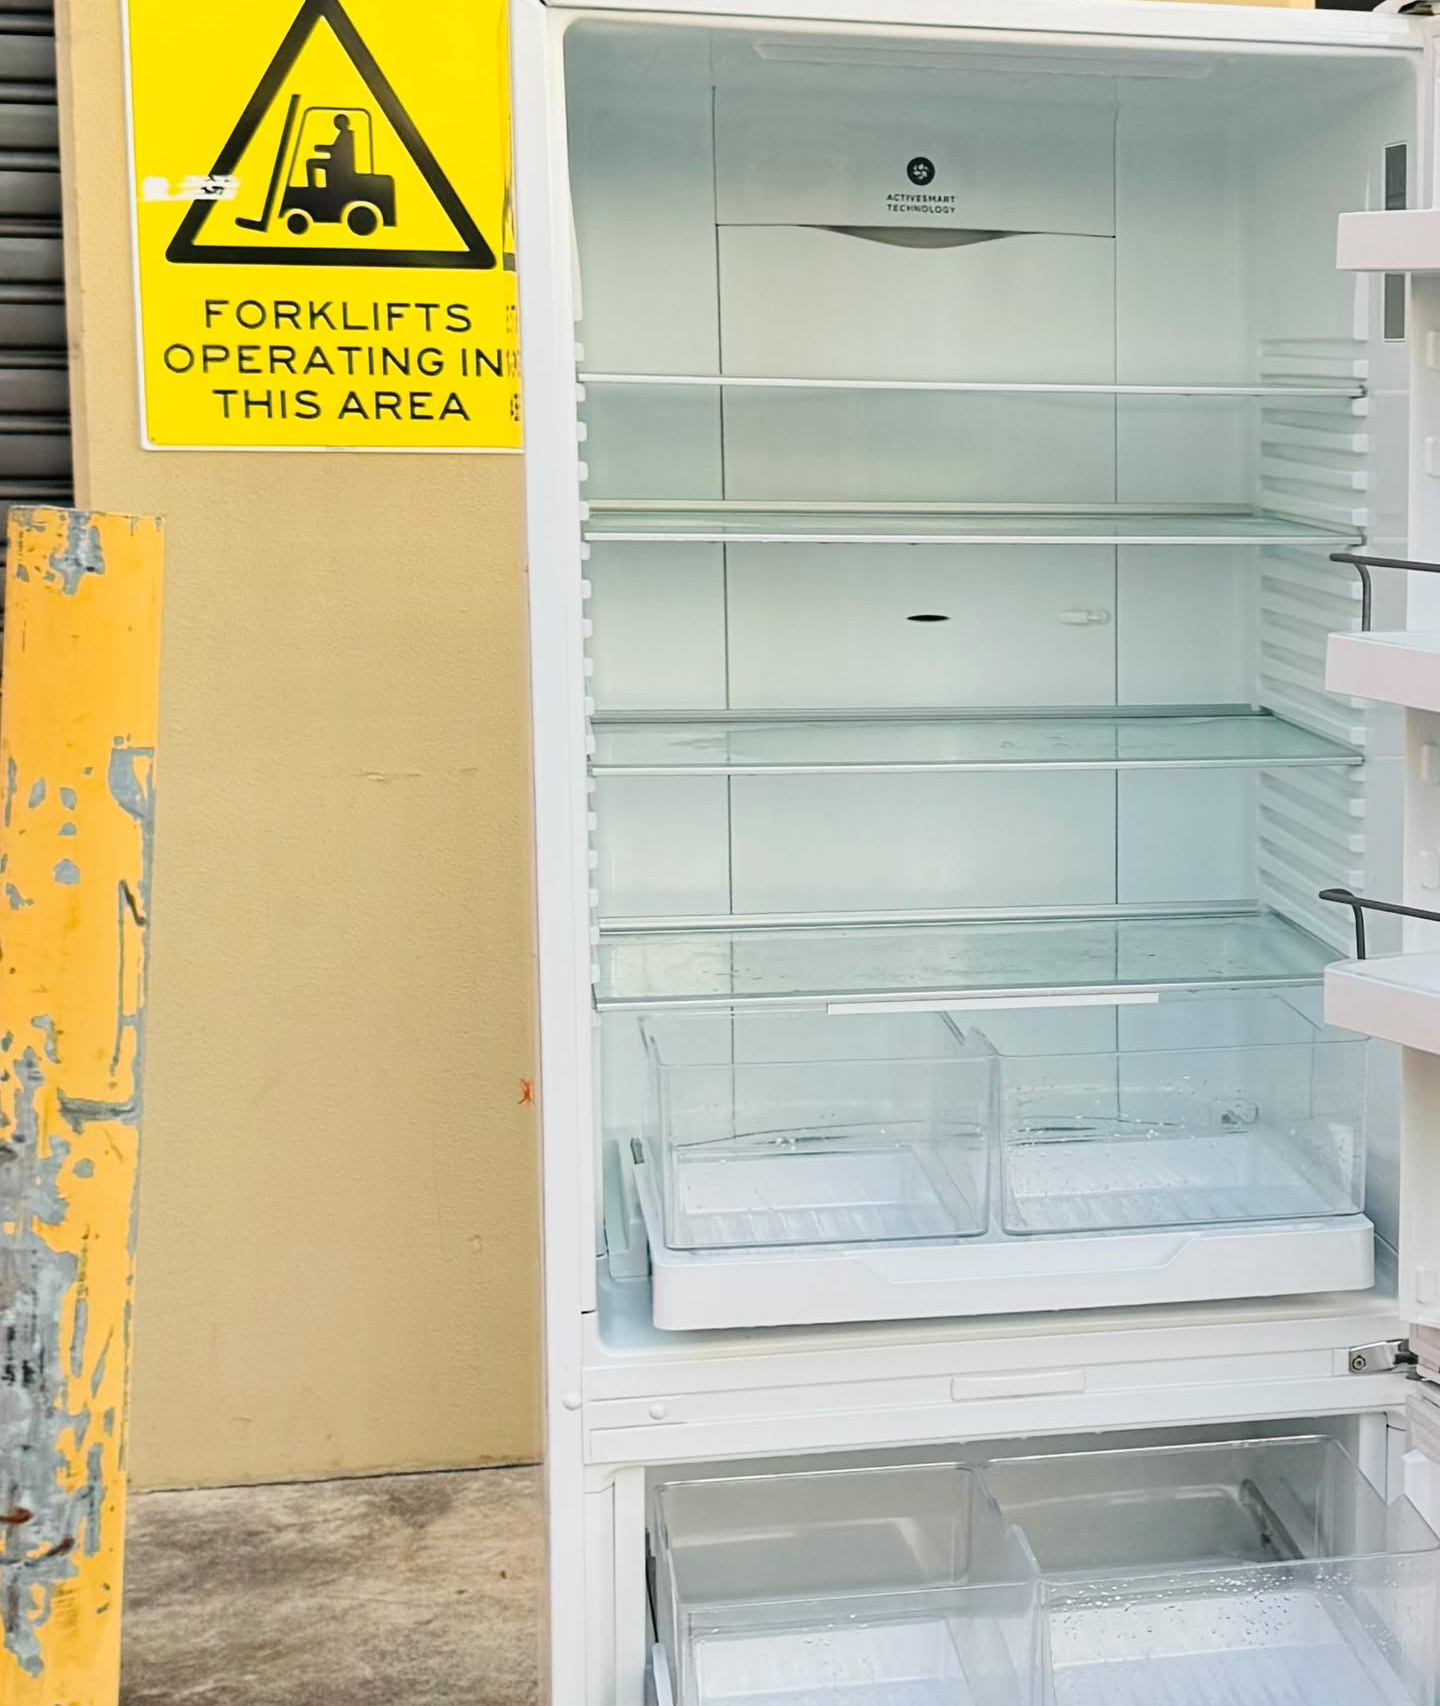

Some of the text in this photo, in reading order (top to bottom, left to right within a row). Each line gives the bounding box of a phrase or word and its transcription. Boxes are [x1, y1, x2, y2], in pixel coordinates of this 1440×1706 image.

[886, 193, 956, 203] ACTIVESMART
[887, 203, 956, 214] TECHNOLOGY
[204, 299, 473, 333] FORKLIFTS
[163, 343, 503, 378] OPERATING IN
[211, 389, 472, 422] THIS AREA
